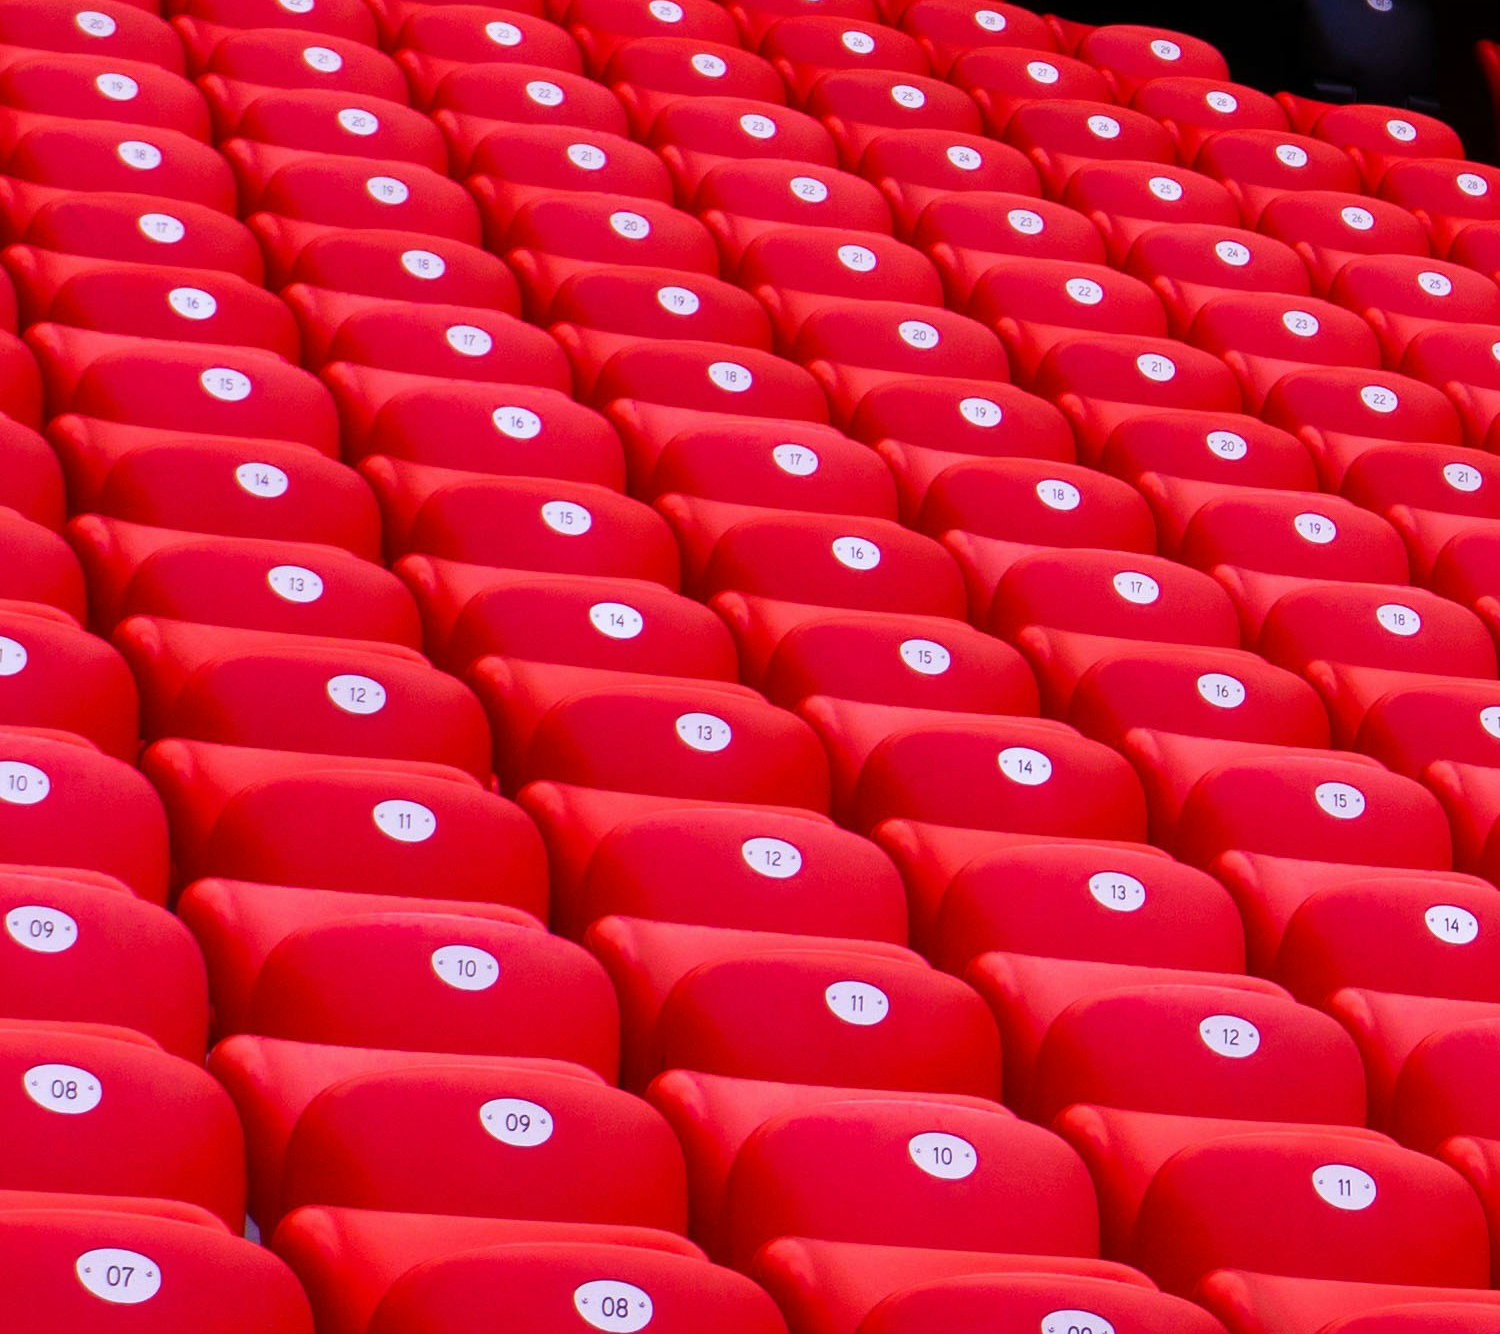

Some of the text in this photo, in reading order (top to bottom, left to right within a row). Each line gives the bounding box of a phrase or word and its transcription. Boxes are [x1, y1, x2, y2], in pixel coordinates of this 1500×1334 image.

[219, 377, 234, 392] 15
[975, 406, 987, 419] 19
[255, 473, 270, 486] 14
[559, 511, 574, 526] 15
[1309, 522, 1322, 535] 19
[851, 546, 864, 560] 16
[289, 577, 305, 593] 13
[610, 613, 625, 628] 14
[918, 649, 933, 665] 15
[350, 687, 367, 704] 12
[1215, 684, 1230, 699] 16
[697, 724, 713, 741] 13
[1018, 759, 1033, 775] 14
[9, 774, 28, 792] 10
[1333, 793, 1348, 809] 15
[398, 812, 412, 830] 11
[765, 850, 782, 867] 12
[1111, 884, 1127, 901] 13
[29, 919, 55, 939] 09
[1444, 917, 1460, 934] 14
[457, 959, 477, 978] 10
[851, 994, 864, 1012] 11
[1222, 1028, 1240, 1046] 12
[51, 1079, 78, 1100] 08
[505, 1113, 531, 1133] 09
[933, 1146, 953, 1166] 10
[1338, 1178, 1351, 1197] 11
[106, 1265, 135, 1288] 07
[601, 1296, 629, 1319] 08
